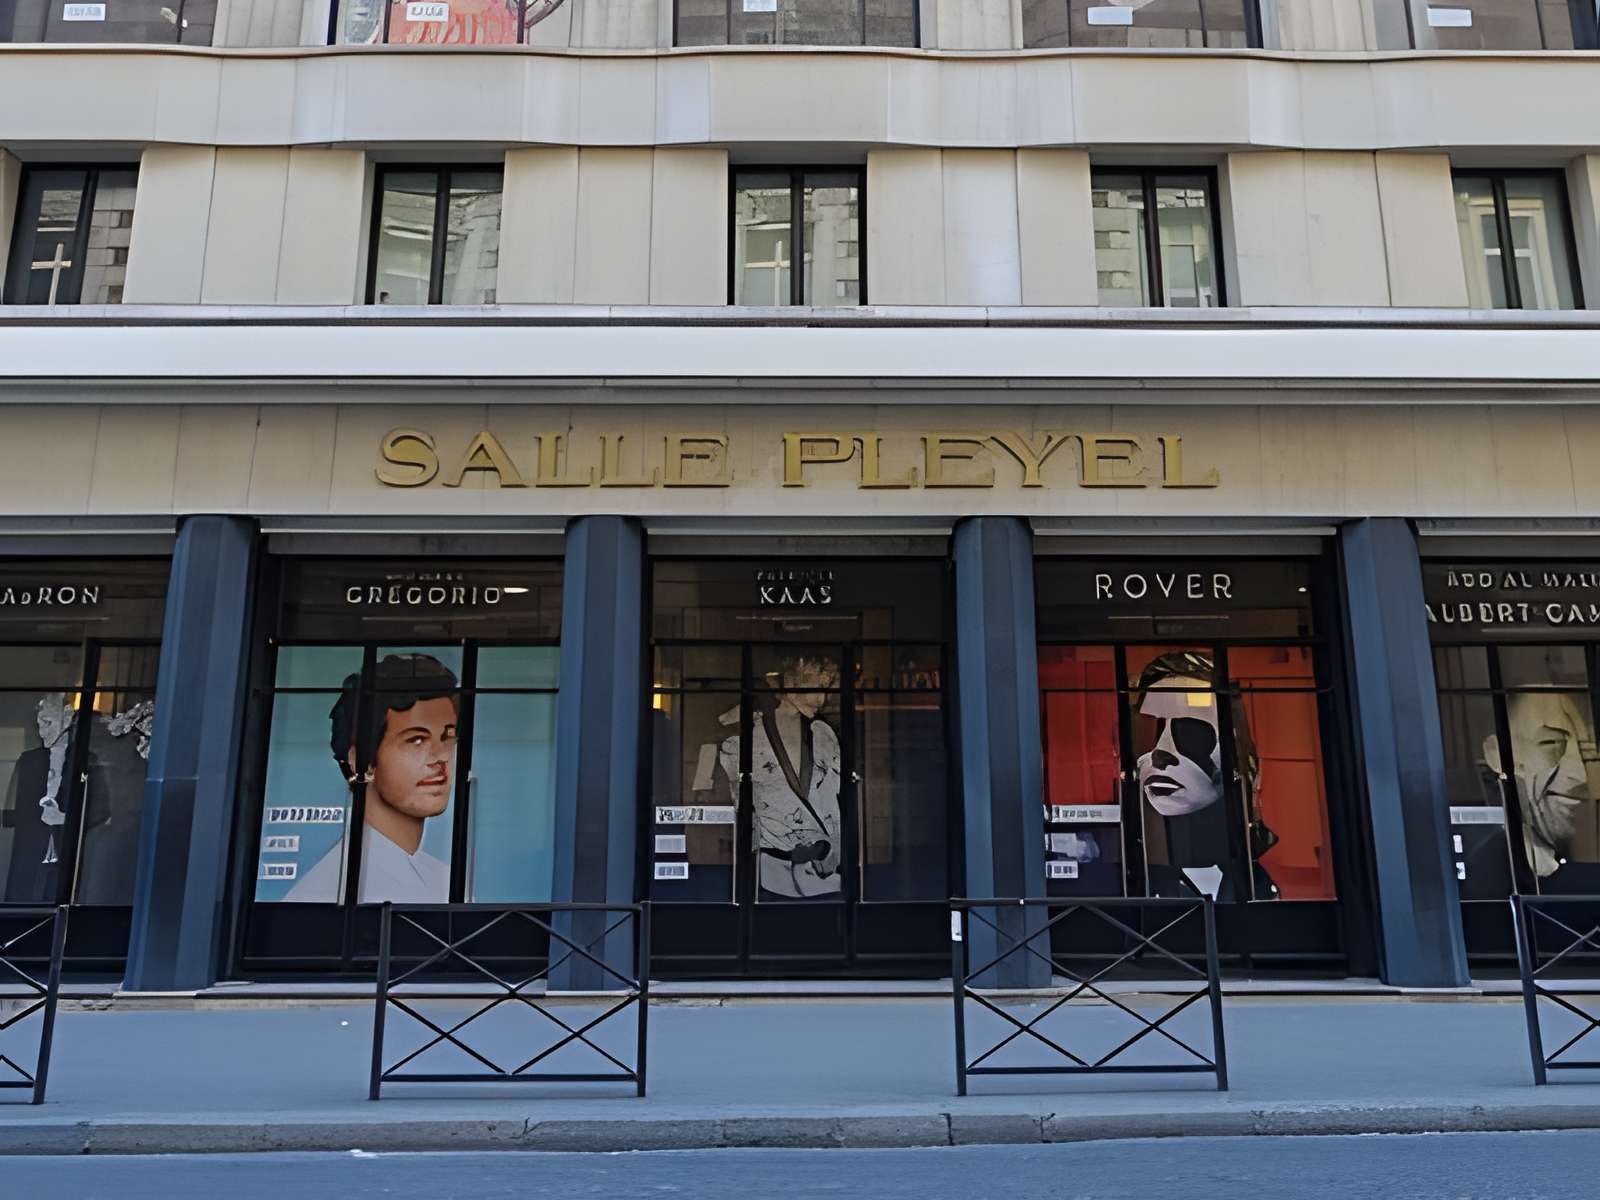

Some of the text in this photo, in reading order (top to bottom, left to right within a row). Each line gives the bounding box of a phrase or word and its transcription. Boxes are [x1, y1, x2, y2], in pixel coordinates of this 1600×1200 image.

[375, 428, 1219, 489] SALLE PLEYEL
[760, 585, 832, 605] KAAS
[1095, 573, 1232, 600] ROVER
